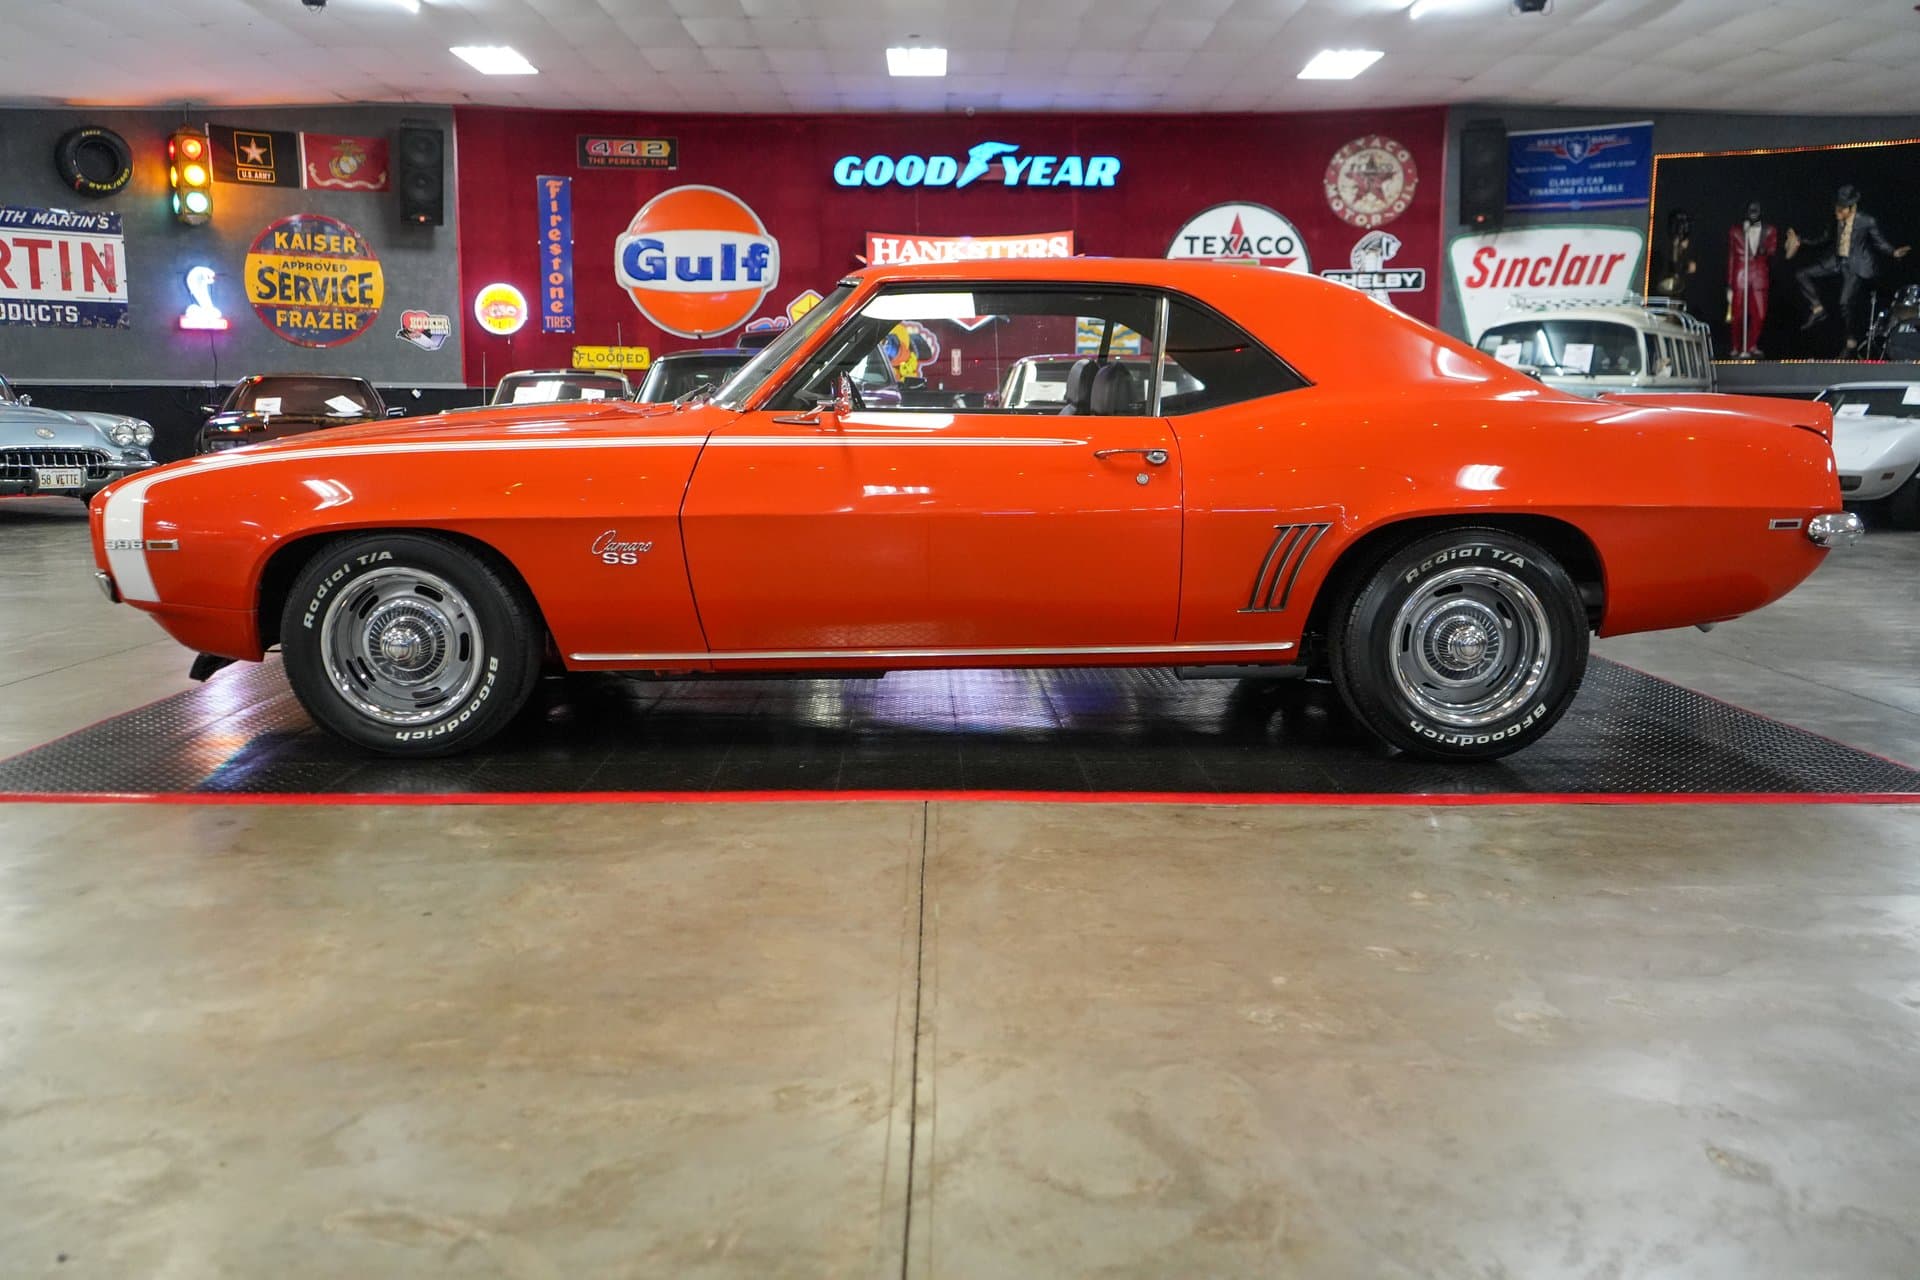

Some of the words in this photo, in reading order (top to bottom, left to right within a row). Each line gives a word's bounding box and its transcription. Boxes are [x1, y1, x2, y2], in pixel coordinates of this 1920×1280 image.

[608, 157, 647, 165] PERFECT
[1330, 138, 1410, 167] TEXACO
[255, 172, 272, 180] ARMY
[32, 212, 110, 229] MARTIN'S
[274, 231, 357, 253] KAISER
[545, 180, 565, 313] Firestone
[871, 237, 1069, 266] HANKSTERS
[1184, 236, 1295, 255] TEXACO
[281, 261, 348, 273] APPROVED
[622, 238, 770, 282] Gulf
[1465, 244, 1627, 289] Sinclair
[257, 266, 374, 305] SERVICE
[275, 309, 359, 330] FRAZER
[545, 315, 572, 328] TIRES
[579, 352, 644, 364] FLOODED
[41, 474, 52, 485] 58
[56, 474, 79, 485] VETTE
[591, 529, 652, 555] Camaro
[602, 552, 638, 565] SS
[1405, 547, 1482, 583] Radial
[1491, 549, 1526, 569] T/A
[303, 563, 351, 629] Radial
[357, 550, 393, 566] T/A
[395, 655, 500, 742] BFGoodrich
[1409, 702, 1547, 747] BFGoodrich
